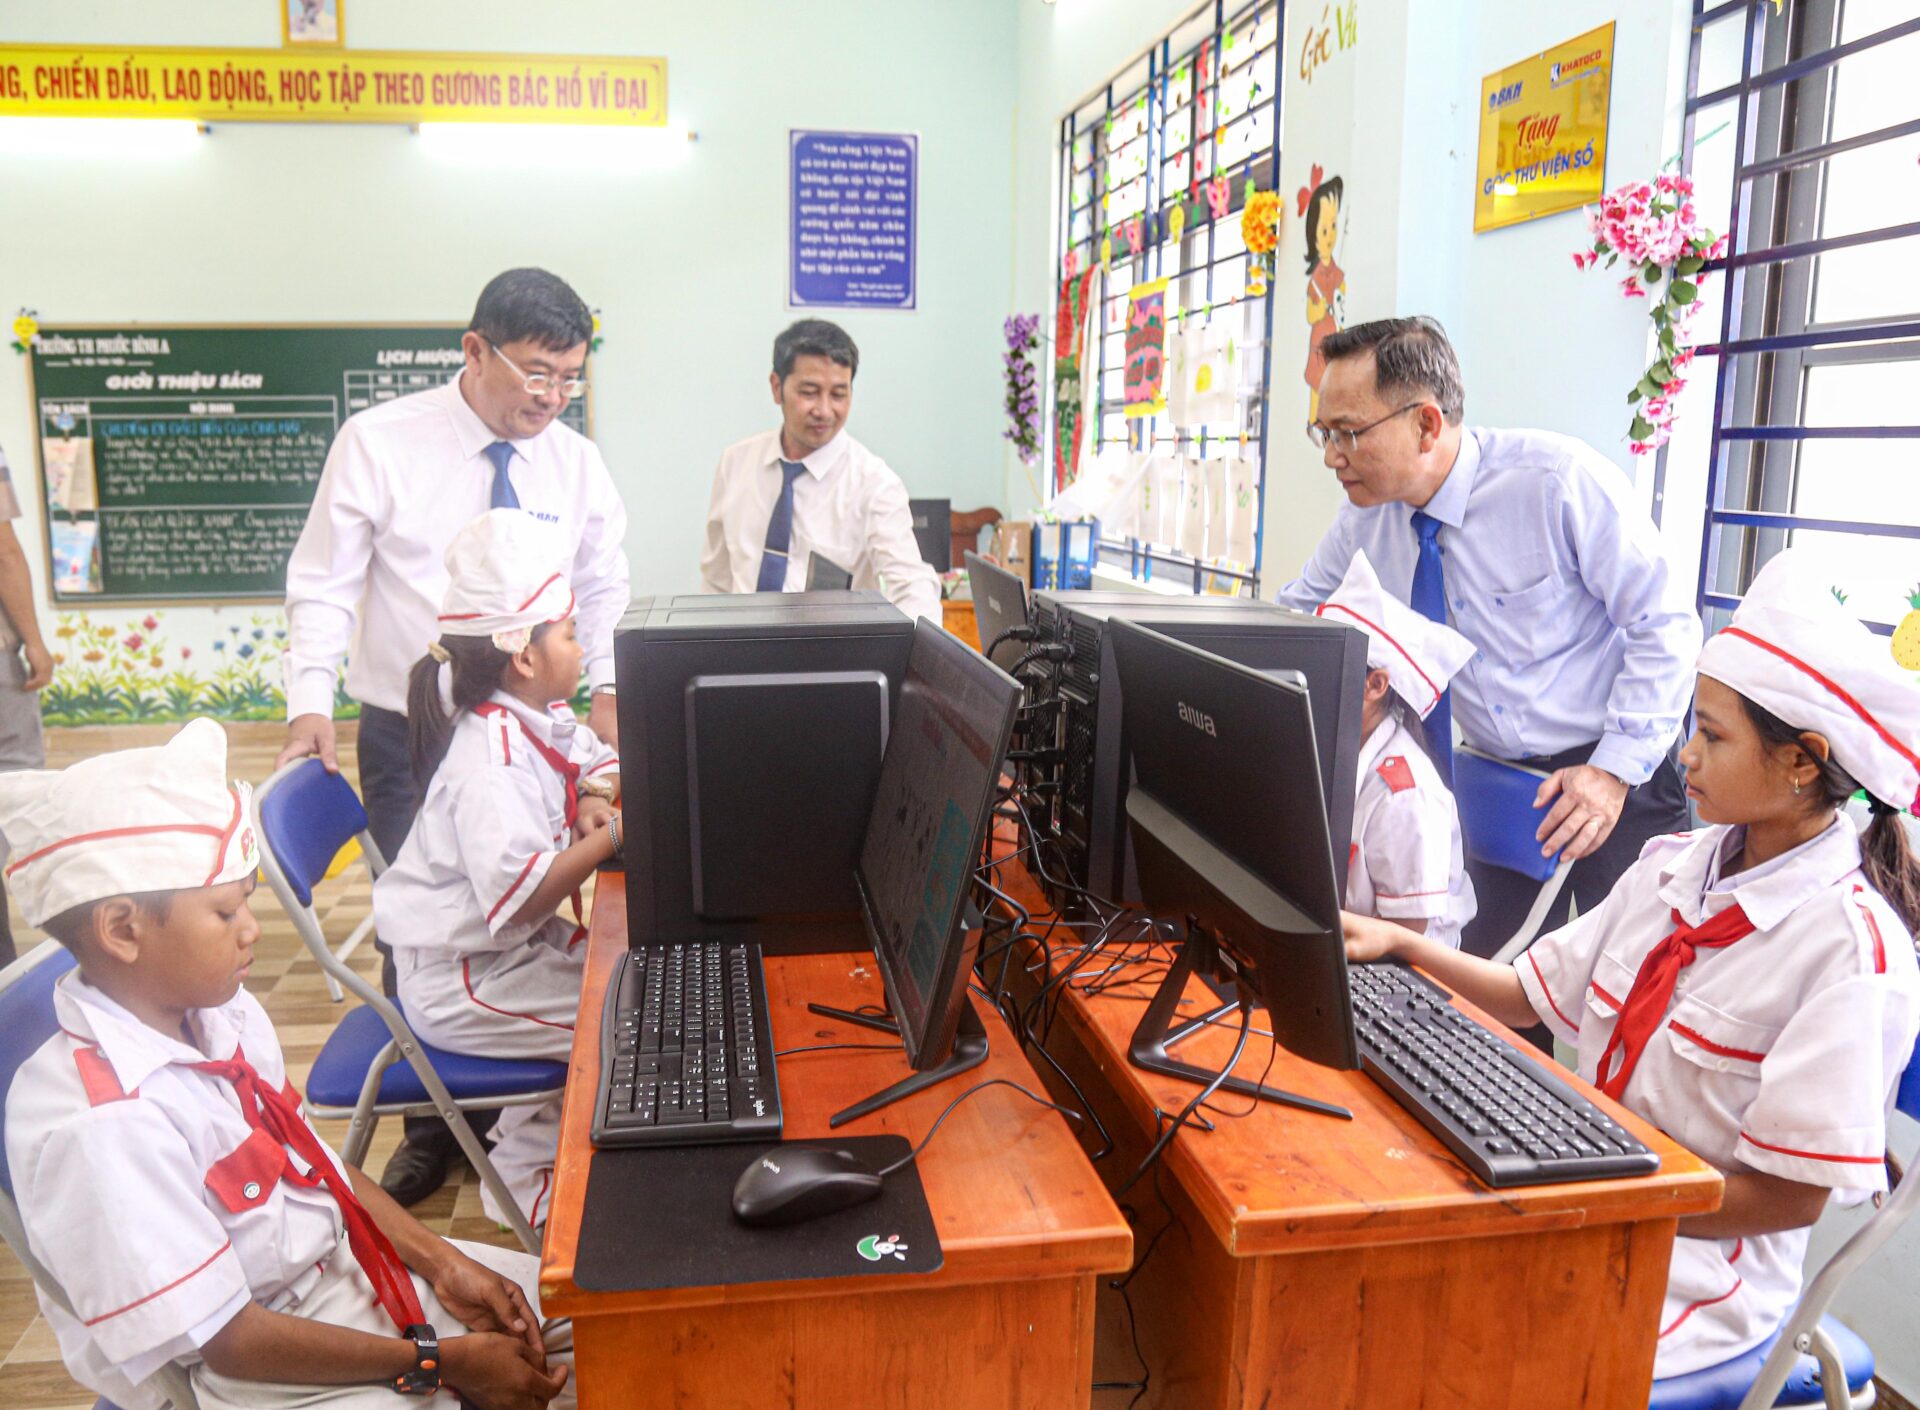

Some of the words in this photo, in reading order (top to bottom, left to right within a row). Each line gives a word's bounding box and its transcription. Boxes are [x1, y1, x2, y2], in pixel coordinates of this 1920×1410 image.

[1561, 48, 1602, 74] KHATOCO
[35, 55, 99, 99] CHIẾN
[107, 55, 157, 104] ĐẤU,
[163, 67, 201, 100] LAO
[209, 61, 274, 110] ĐỘNG,
[280, 70, 321, 110] HỌC
[327, 64, 367, 111] TẬP
[373, 72, 424, 105] THEO
[431, 71, 502, 106] GƯƠNG
[508, 67, 549, 107] BÁC
[556, 65, 581, 109] HỒ
[614, 78, 647, 117] ĐẠI
[1516, 112, 1561, 150] Tặng
[1515, 160, 1540, 185] THƯ
[1542, 151, 1571, 180] VIỆN
[1573, 137, 1595, 169] SỐ
[160, 338, 171, 354] A
[157, 370, 217, 393] THIỆU
[219, 370, 263, 389] SÁCH
[1178, 701, 1217, 738] aiwa
